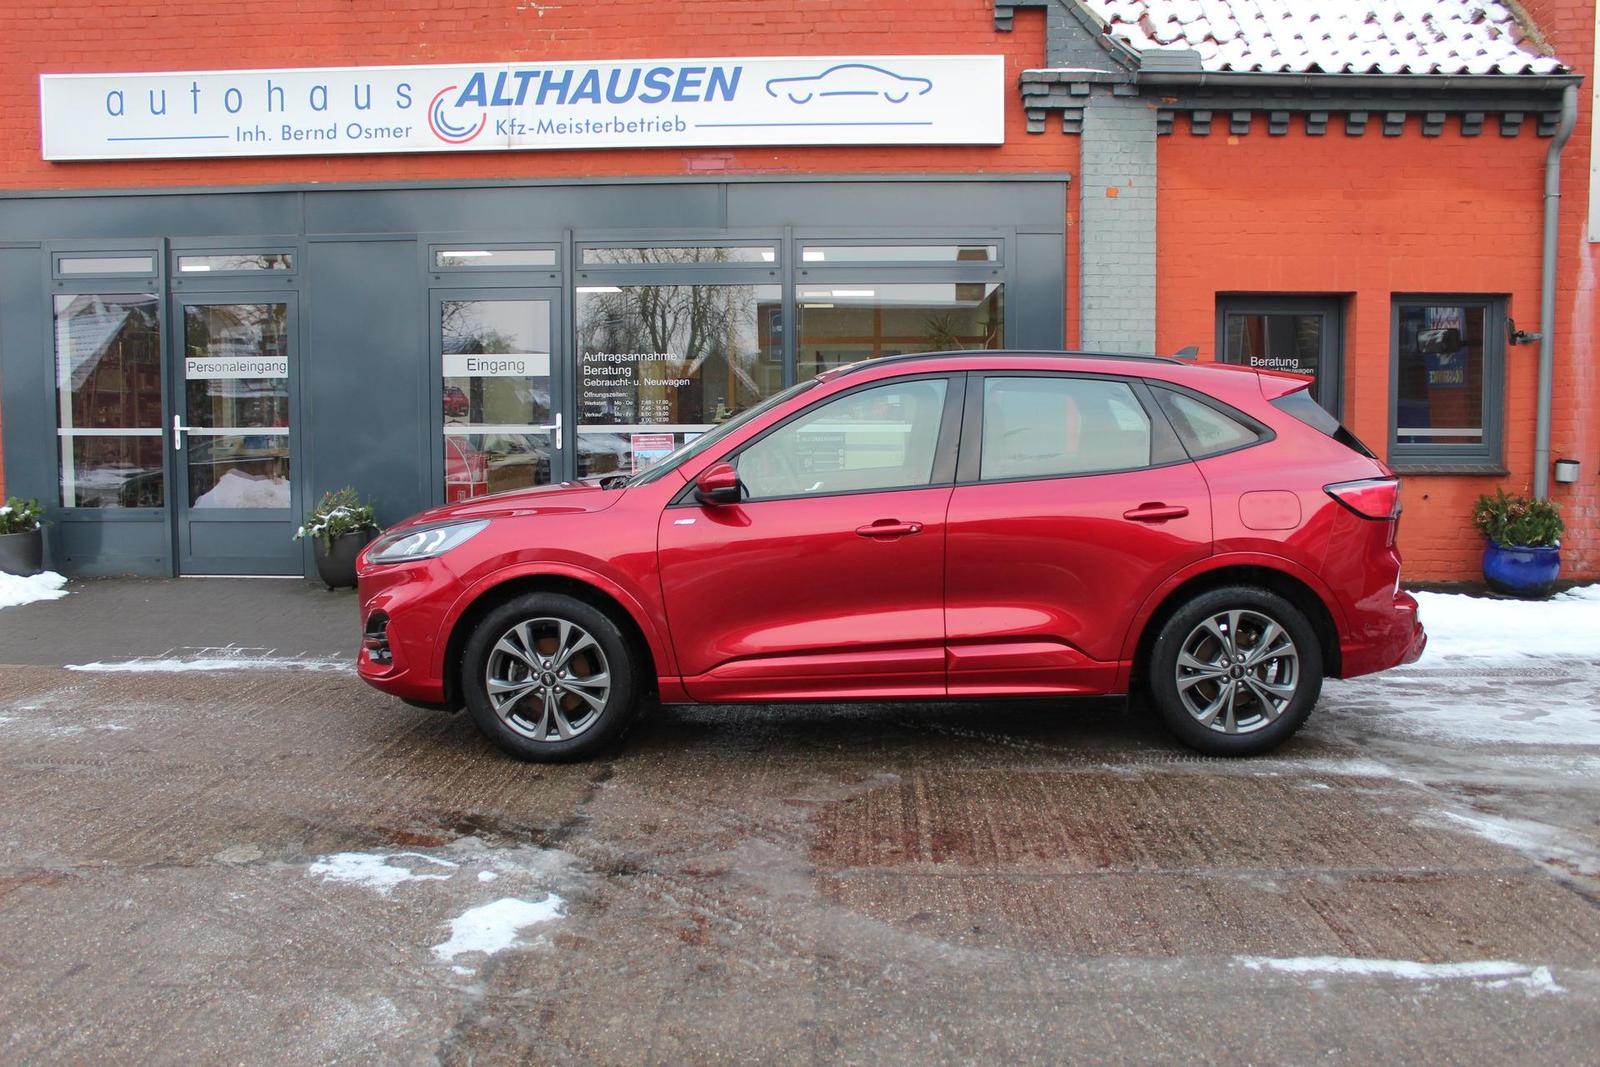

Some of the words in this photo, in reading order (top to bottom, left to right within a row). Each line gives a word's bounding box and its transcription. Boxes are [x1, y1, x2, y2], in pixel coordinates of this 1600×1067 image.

[455, 66, 743, 107] ALTHAUSEN
[105, 79, 413, 116] autohaus
[236, 125, 272, 143] Inh.
[281, 123, 338, 141] Bernd
[345, 122, 413, 140] Osmer
[495, 115, 687, 135] Kfz-Meisterbetrieb
[583, 351, 678, 364] Auftragsannahme
[1250, 356, 1299, 369] Beratung
[187, 360, 287, 375] Personaleingang
[466, 357, 526, 375] Eingang
[583, 365, 632, 377] Beratung
[583, 378, 632, 387] Gebraucht-
[644, 378, 691, 388] Neuwagen
